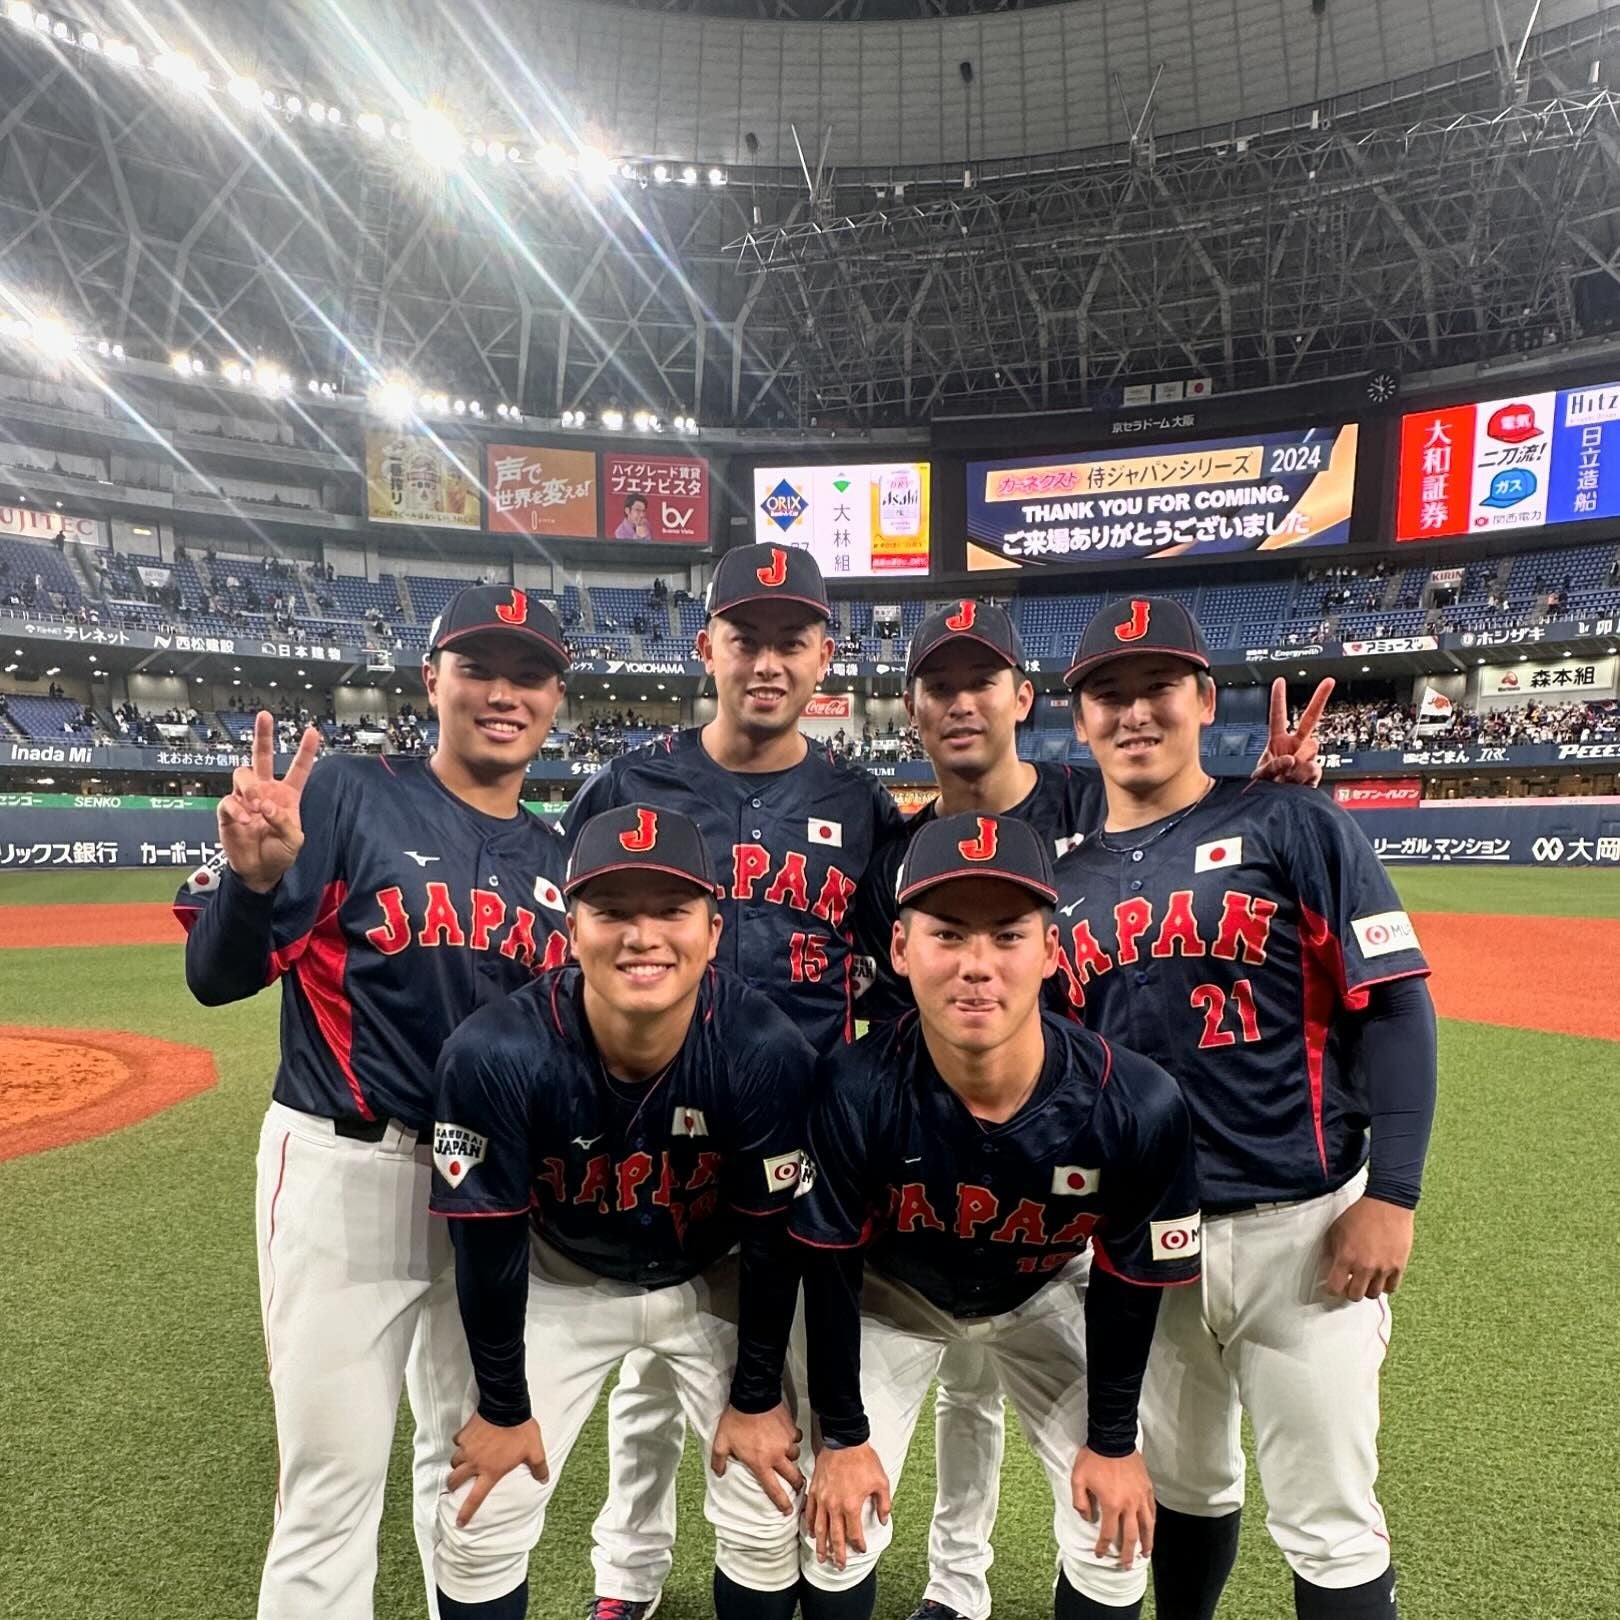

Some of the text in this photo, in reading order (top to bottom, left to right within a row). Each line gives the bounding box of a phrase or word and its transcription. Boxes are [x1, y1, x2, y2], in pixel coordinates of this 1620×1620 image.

[999, 445, 1321, 495] カーネクスト 侍ジャパンシリーズ 2024
[1478, 442, 1547, 467] 二刀流!
[1574, 426, 1602, 512] 日立造船
[494, 455, 542, 490] 声で
[611, 476, 702, 496] ブエナビスタ
[1420, 419, 1453, 531] 大和証券
[1495, 479, 1522, 494] ガス
[495, 477, 592, 512] 世界を変える!
[766, 496, 802, 510] ORIX
[882, 489, 918, 506] Asahi
[1022, 484, 1289, 523] THANK YOU FOR COMING.
[1002, 511, 1312, 556] ご来場ありがとうございました
[1492, 511, 1542, 525] 関西電力
[833, 503, 851, 572] 大林組
[757, 548, 787, 586] J
[1432, 570, 1464, 582] KIRIN
[496, 589, 528, 625] J
[945, 599, 976, 631] J
[1115, 600, 1150, 642] J
[64, 626, 129, 645] テレネット
[1476, 626, 1545, 646] ホシザキ
[625, 663, 685, 674] YOKOHAMA
[1530, 666, 1595, 688] 森本組
[11, 744, 92, 763] Inada Mi
[74, 796, 121, 809] SENKO
[151, 797, 193, 809] センコー
[619, 808, 657, 852] J
[958, 817, 998, 861] J
[716, 843, 857, 928] PAN
[789, 932, 828, 983] 15
[1190, 979, 1262, 1049] 21
[435, 1139, 482, 1159] JAPAN
